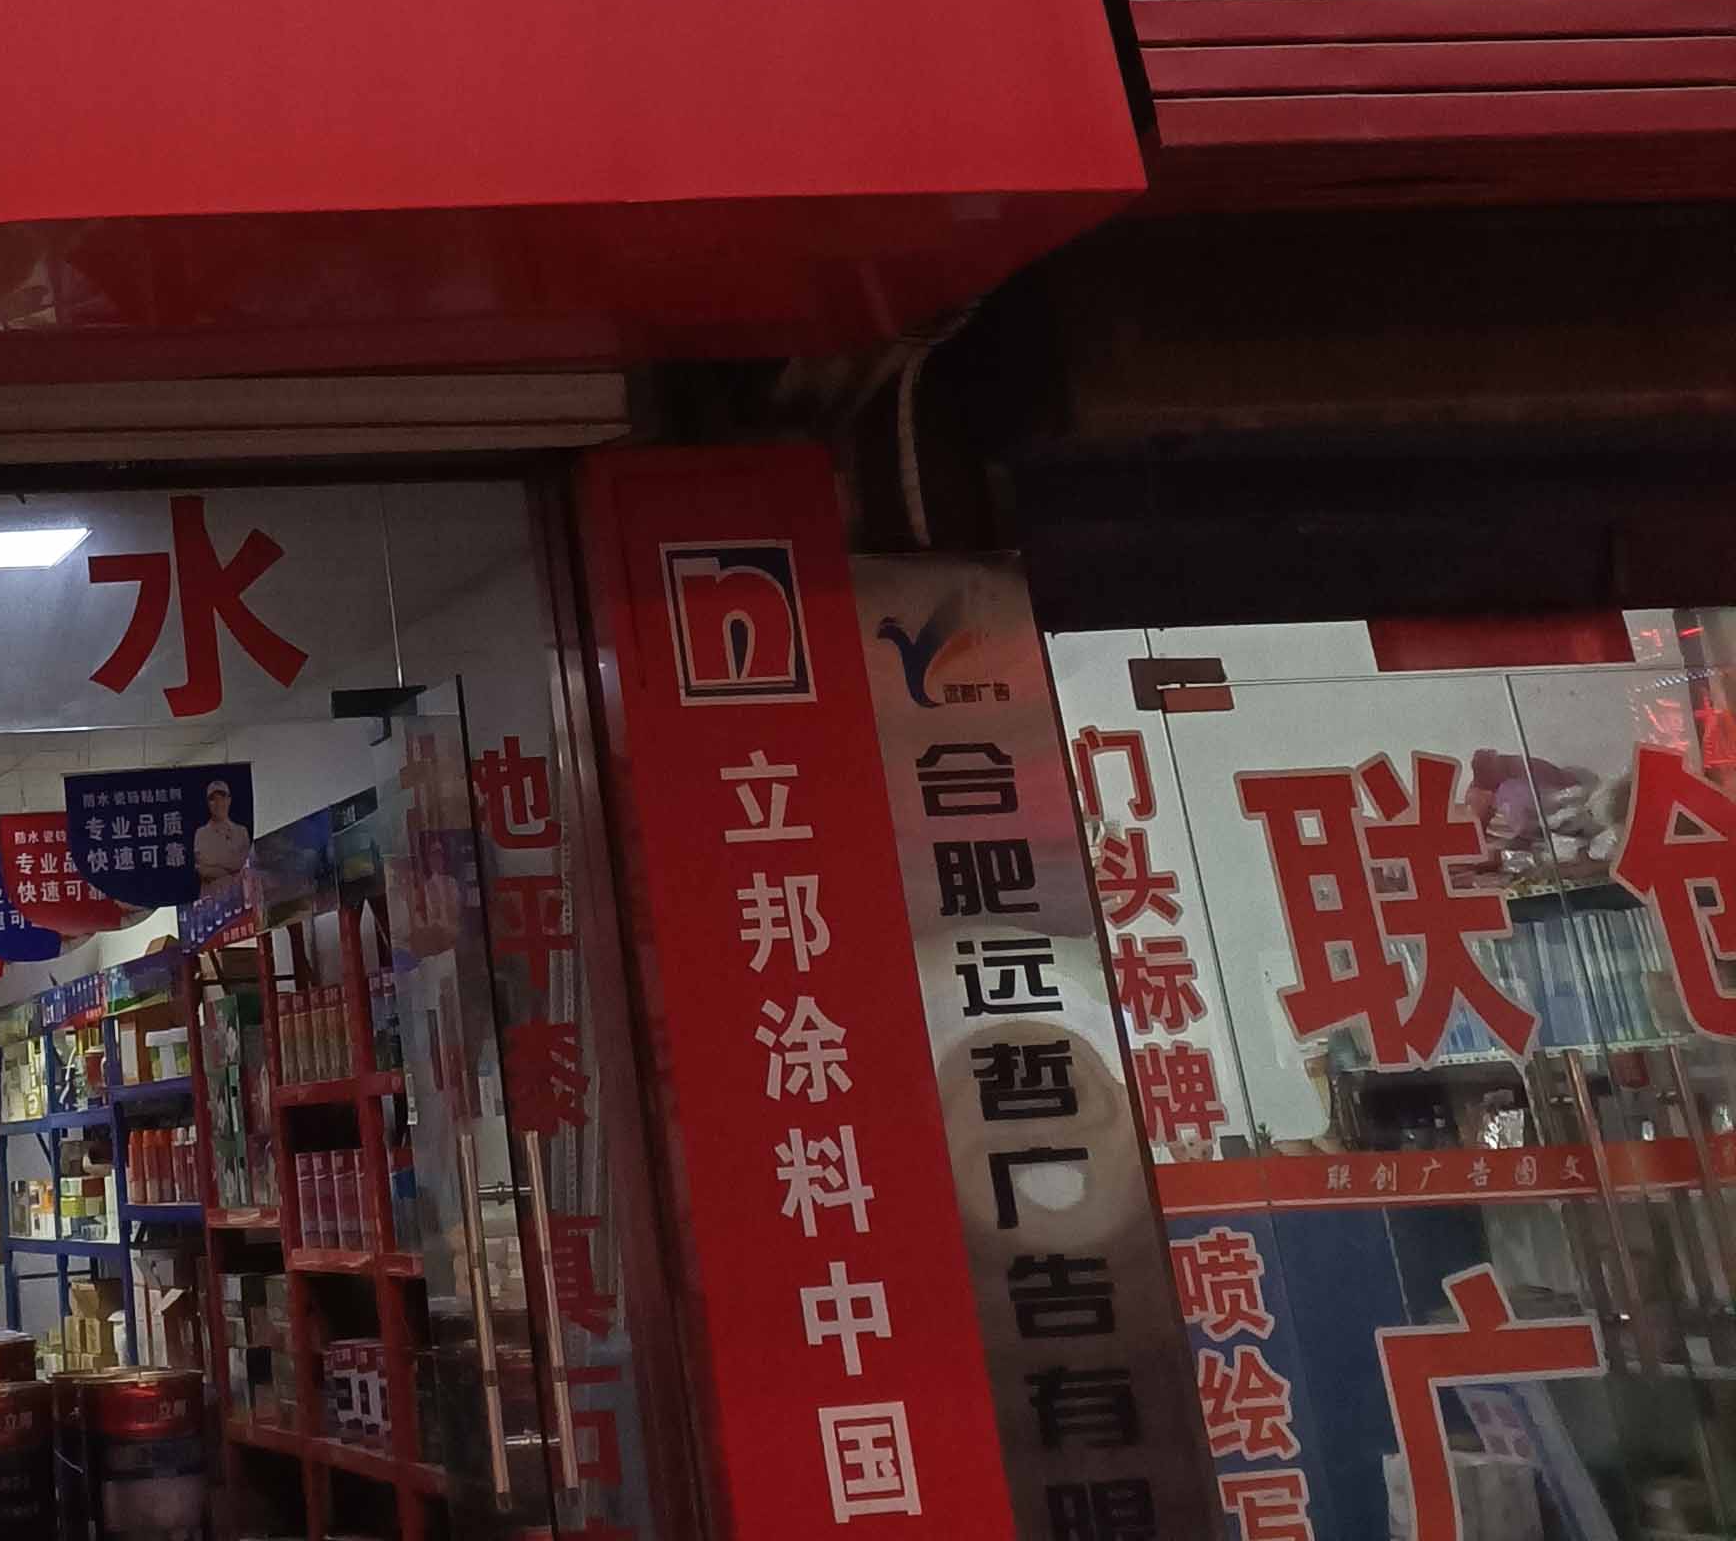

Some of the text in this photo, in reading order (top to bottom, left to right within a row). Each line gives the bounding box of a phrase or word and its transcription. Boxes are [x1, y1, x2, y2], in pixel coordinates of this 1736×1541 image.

[85, 811, 184, 841] 专业品质
[87, 842, 186, 873] 快速可靠
[1070, 725, 1230, 1145] 门头标牌
[719, 749, 922, 1524] 立邦涂料中国
